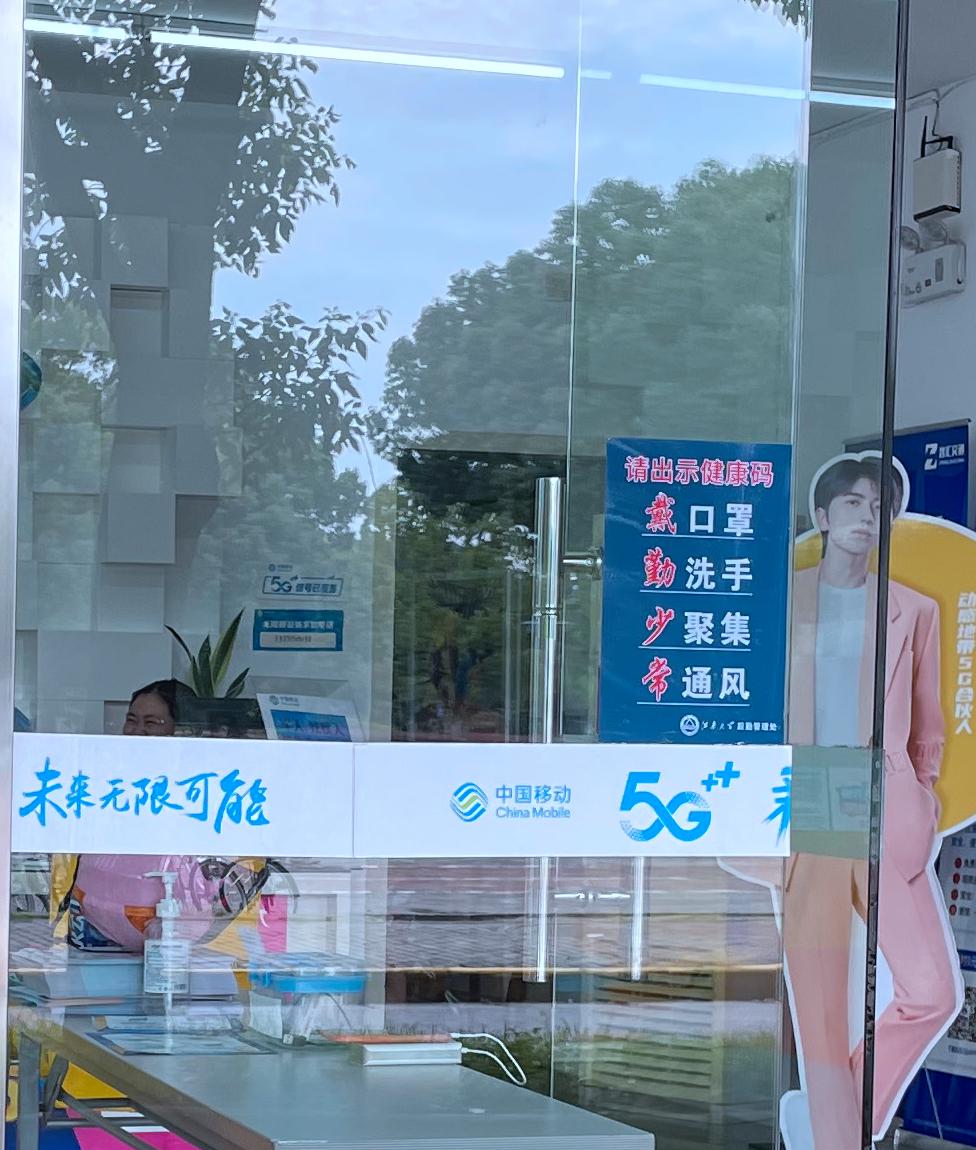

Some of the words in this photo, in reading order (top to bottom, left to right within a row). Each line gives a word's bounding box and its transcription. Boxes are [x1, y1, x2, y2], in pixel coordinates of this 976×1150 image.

[624, 455, 774, 488] 请出示健康码
[644, 492, 754, 537] 戴口罩
[643, 546, 753, 592] 勤洗手
[642, 606, 750, 646] 少聚集
[641, 656, 750, 702] 常通风
[19, 757, 270, 834] 未来无限可能
[496, 784, 571, 804] 中国移动
[496, 806, 530, 818] China
[532, 806, 571, 818] Mobile
